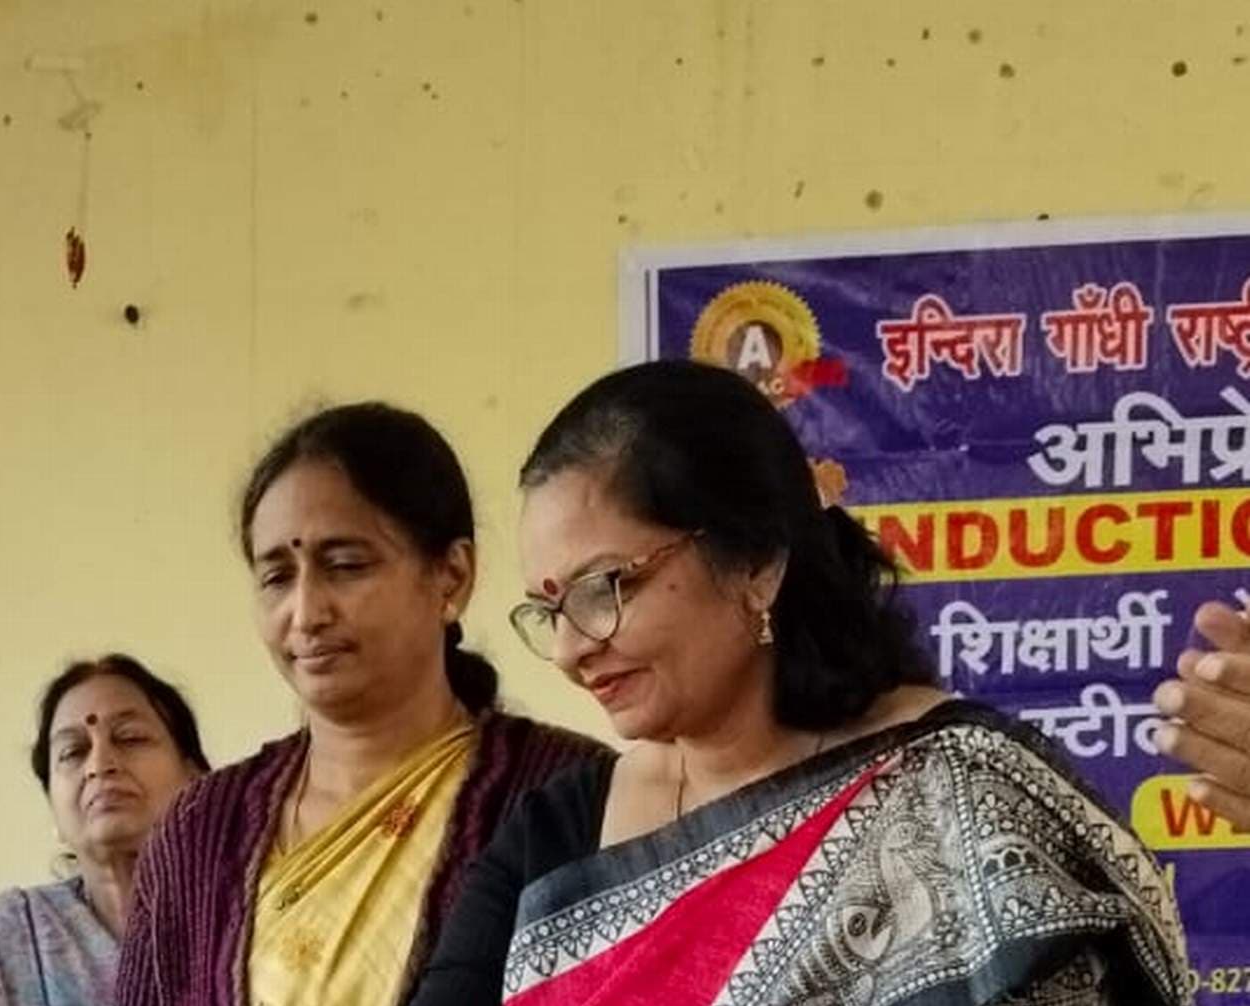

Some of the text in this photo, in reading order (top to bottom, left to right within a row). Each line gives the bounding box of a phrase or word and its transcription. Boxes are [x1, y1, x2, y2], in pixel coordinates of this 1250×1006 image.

[877, 294, 1025, 392] इन्दिरा
[1042, 282, 1154, 372] गाँधी
[930, 590, 1172, 676] शिक्षार्थी
